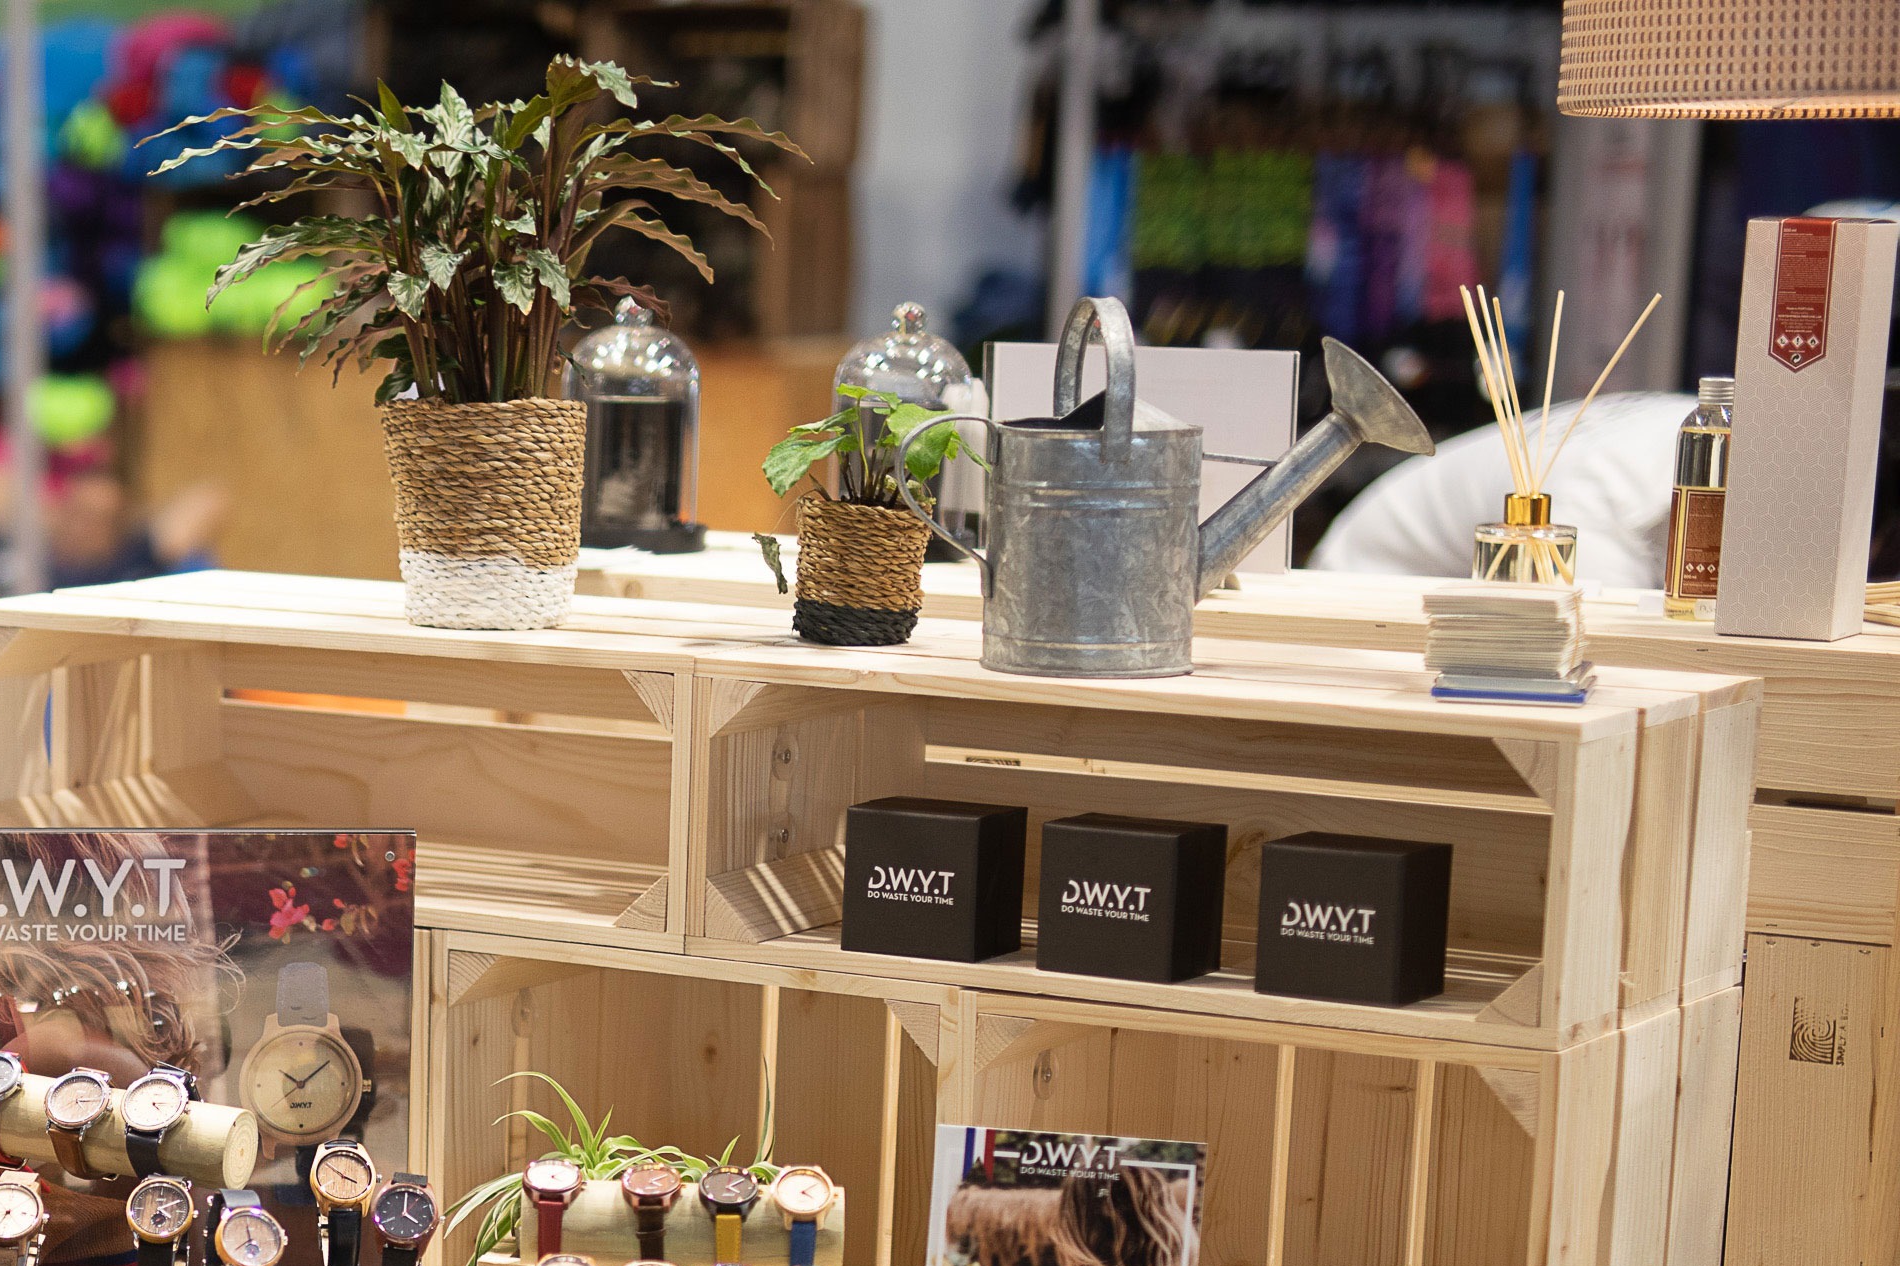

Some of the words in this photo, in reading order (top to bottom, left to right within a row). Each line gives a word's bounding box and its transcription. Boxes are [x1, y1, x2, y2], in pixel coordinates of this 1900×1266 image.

[868, 866, 955, 895] D.W.Y.T
[882, 892, 908, 902] WASTE
[910, 894, 933, 904] YOUR
[934, 897, 954, 905] TIME
[1062, 880, 1151, 911] D.W.Y.T
[1061, 905, 1074, 913] DO
[1076, 906, 1103, 917] WASTE
[1105, 910, 1128, 919] YOUR
[1129, 912, 1149, 922] TIME
[1282, 902, 1376, 933] D.W.Y.T
[65, 924, 127, 942] YOUR
[134, 924, 186, 942] TIME
[1281, 928, 1295, 936] DO
[1296, 929, 1325, 940] WASTE
[1327, 932, 1351, 943] YOUR
[1353, 935, 1375, 945] TIME
[1021, 1141, 1120, 1170] D.W.Y.T
[1020, 1166, 1035, 1174] DO
[1037, 1167, 1067, 1177] WASTE
[1069, 1170, 1096, 1179] YOUR
[1098, 1172, 1120, 1181] TIME
